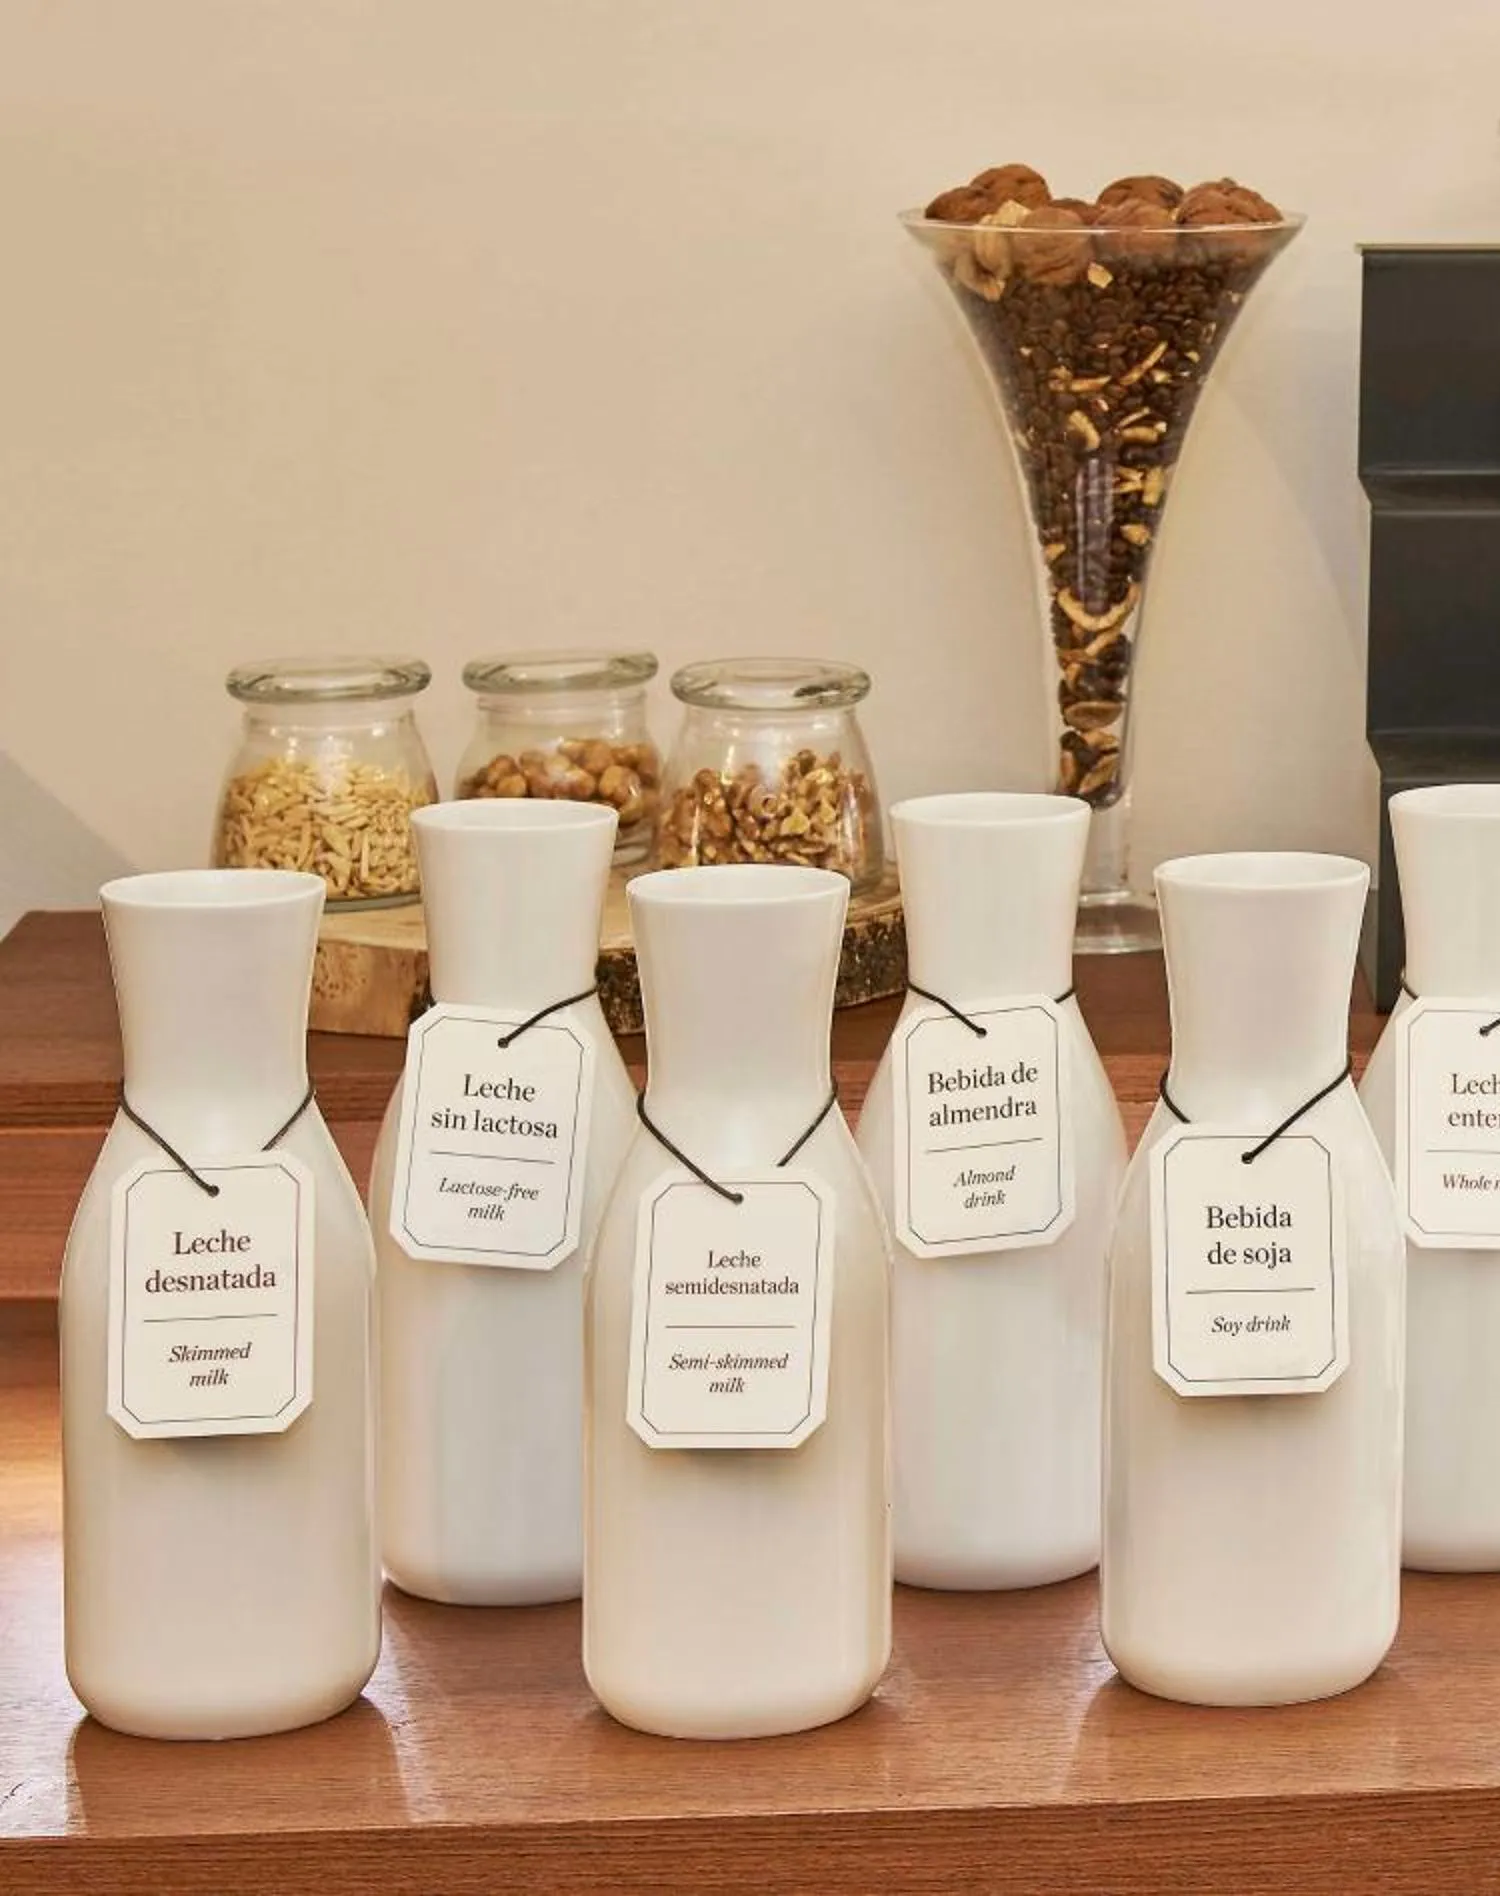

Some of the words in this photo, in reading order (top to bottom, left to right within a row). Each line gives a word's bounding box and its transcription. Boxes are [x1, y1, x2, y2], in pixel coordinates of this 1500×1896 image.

[463, 1073, 536, 1103] Leche
[928, 1065, 1005, 1095] Bebida
[1011, 1061, 1039, 1084] de
[929, 1096, 1037, 1128] almendra
[431, 1108, 467, 1131] sin
[473, 1109, 558, 1140] lactosa
[953, 1165, 1016, 1188] Almond
[1442, 1173, 1492, 1192] Whole
[439, 1177, 540, 1202] Lactose-free
[964, 1190, 1006, 1209] drink
[467, 1204, 506, 1222] milk
[1205, 1203, 1293, 1230] Bebida
[173, 1229, 252, 1256] Leche
[707, 1249, 761, 1269] Leche
[1207, 1241, 1237, 1266] de
[1243, 1241, 1292, 1270] soja
[144, 1264, 277, 1294] desnatada
[665, 1276, 800, 1296] semidesnatada
[1211, 1316, 1243, 1337] Soy
[1246, 1314, 1291, 1333] drink
[168, 1342, 253, 1363] Skimmed
[668, 1353, 790, 1371] Semi-skimmed
[189, 1368, 230, 1388] milk
[708, 1376, 746, 1394] milk
